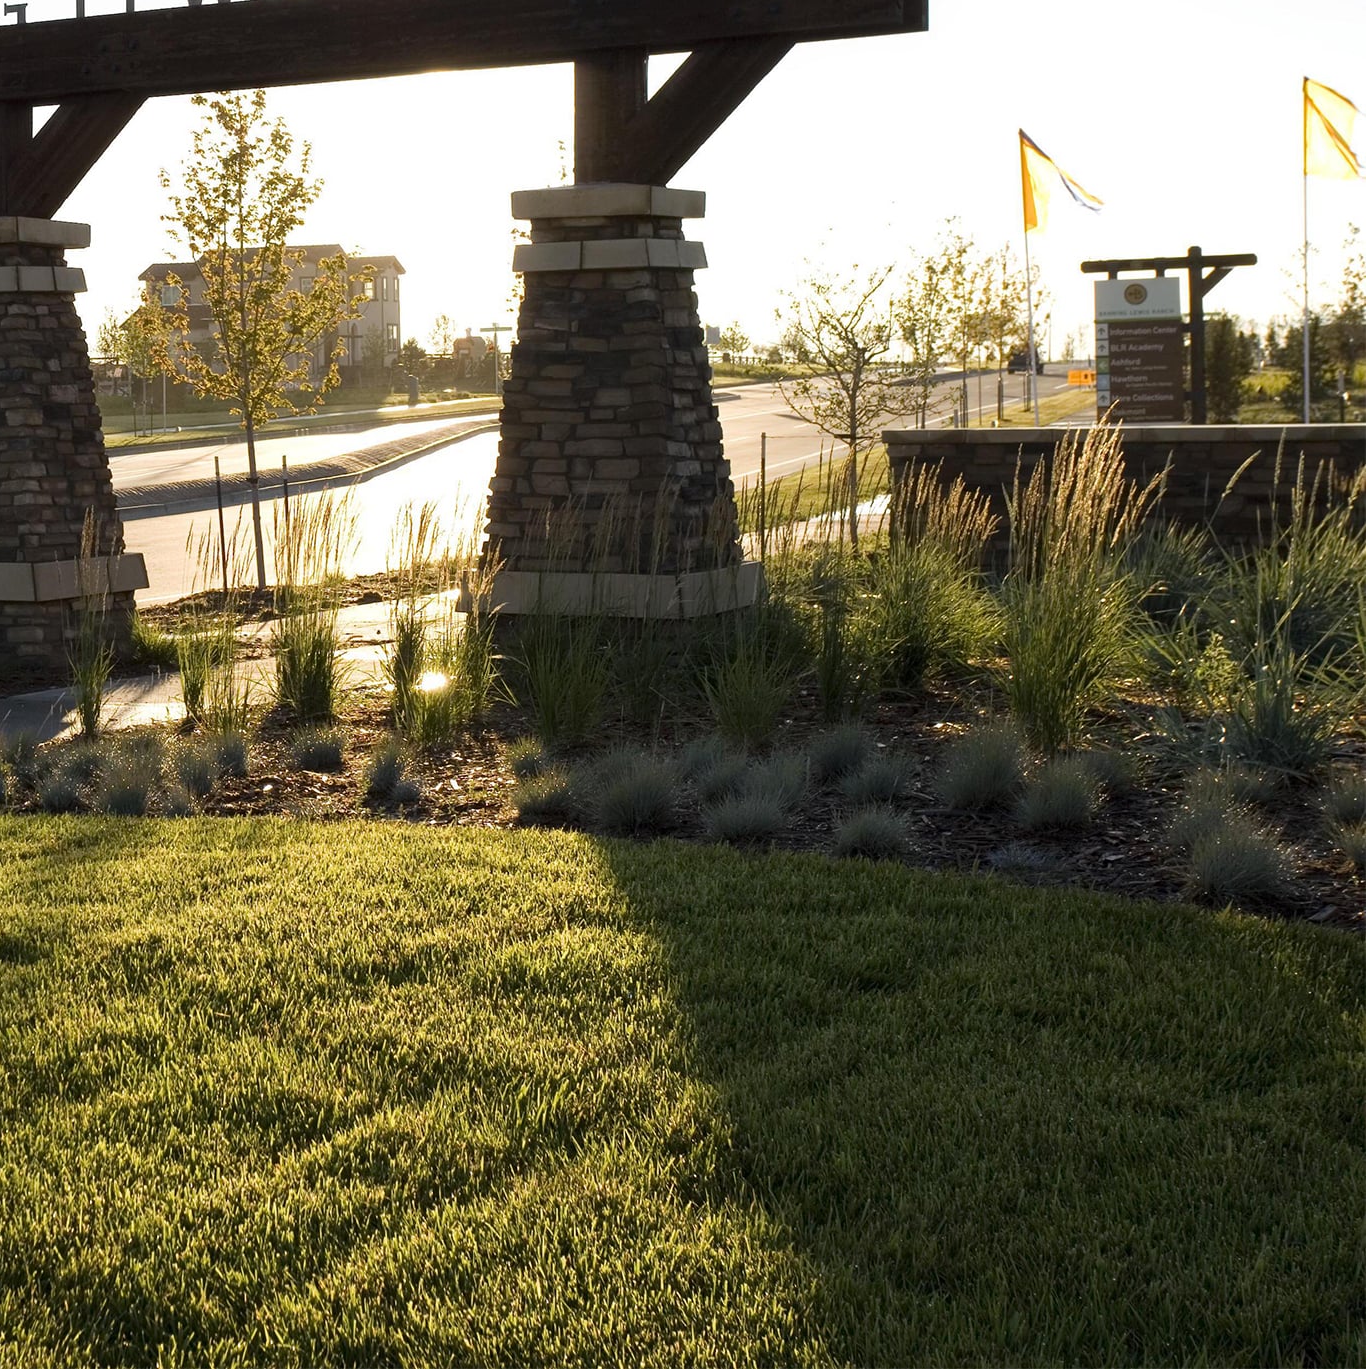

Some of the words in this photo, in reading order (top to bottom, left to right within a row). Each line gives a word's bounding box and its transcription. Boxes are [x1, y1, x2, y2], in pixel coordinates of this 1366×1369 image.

[1109, 327, 1152, 336] Information
[1153, 326, 1177, 334] Center
[1128, 343, 1164, 353] Academy
[1110, 358, 1141, 366] Ashford
[1111, 375, 1148, 383] Hawthorn
[1132, 393, 1174, 402] Collections
